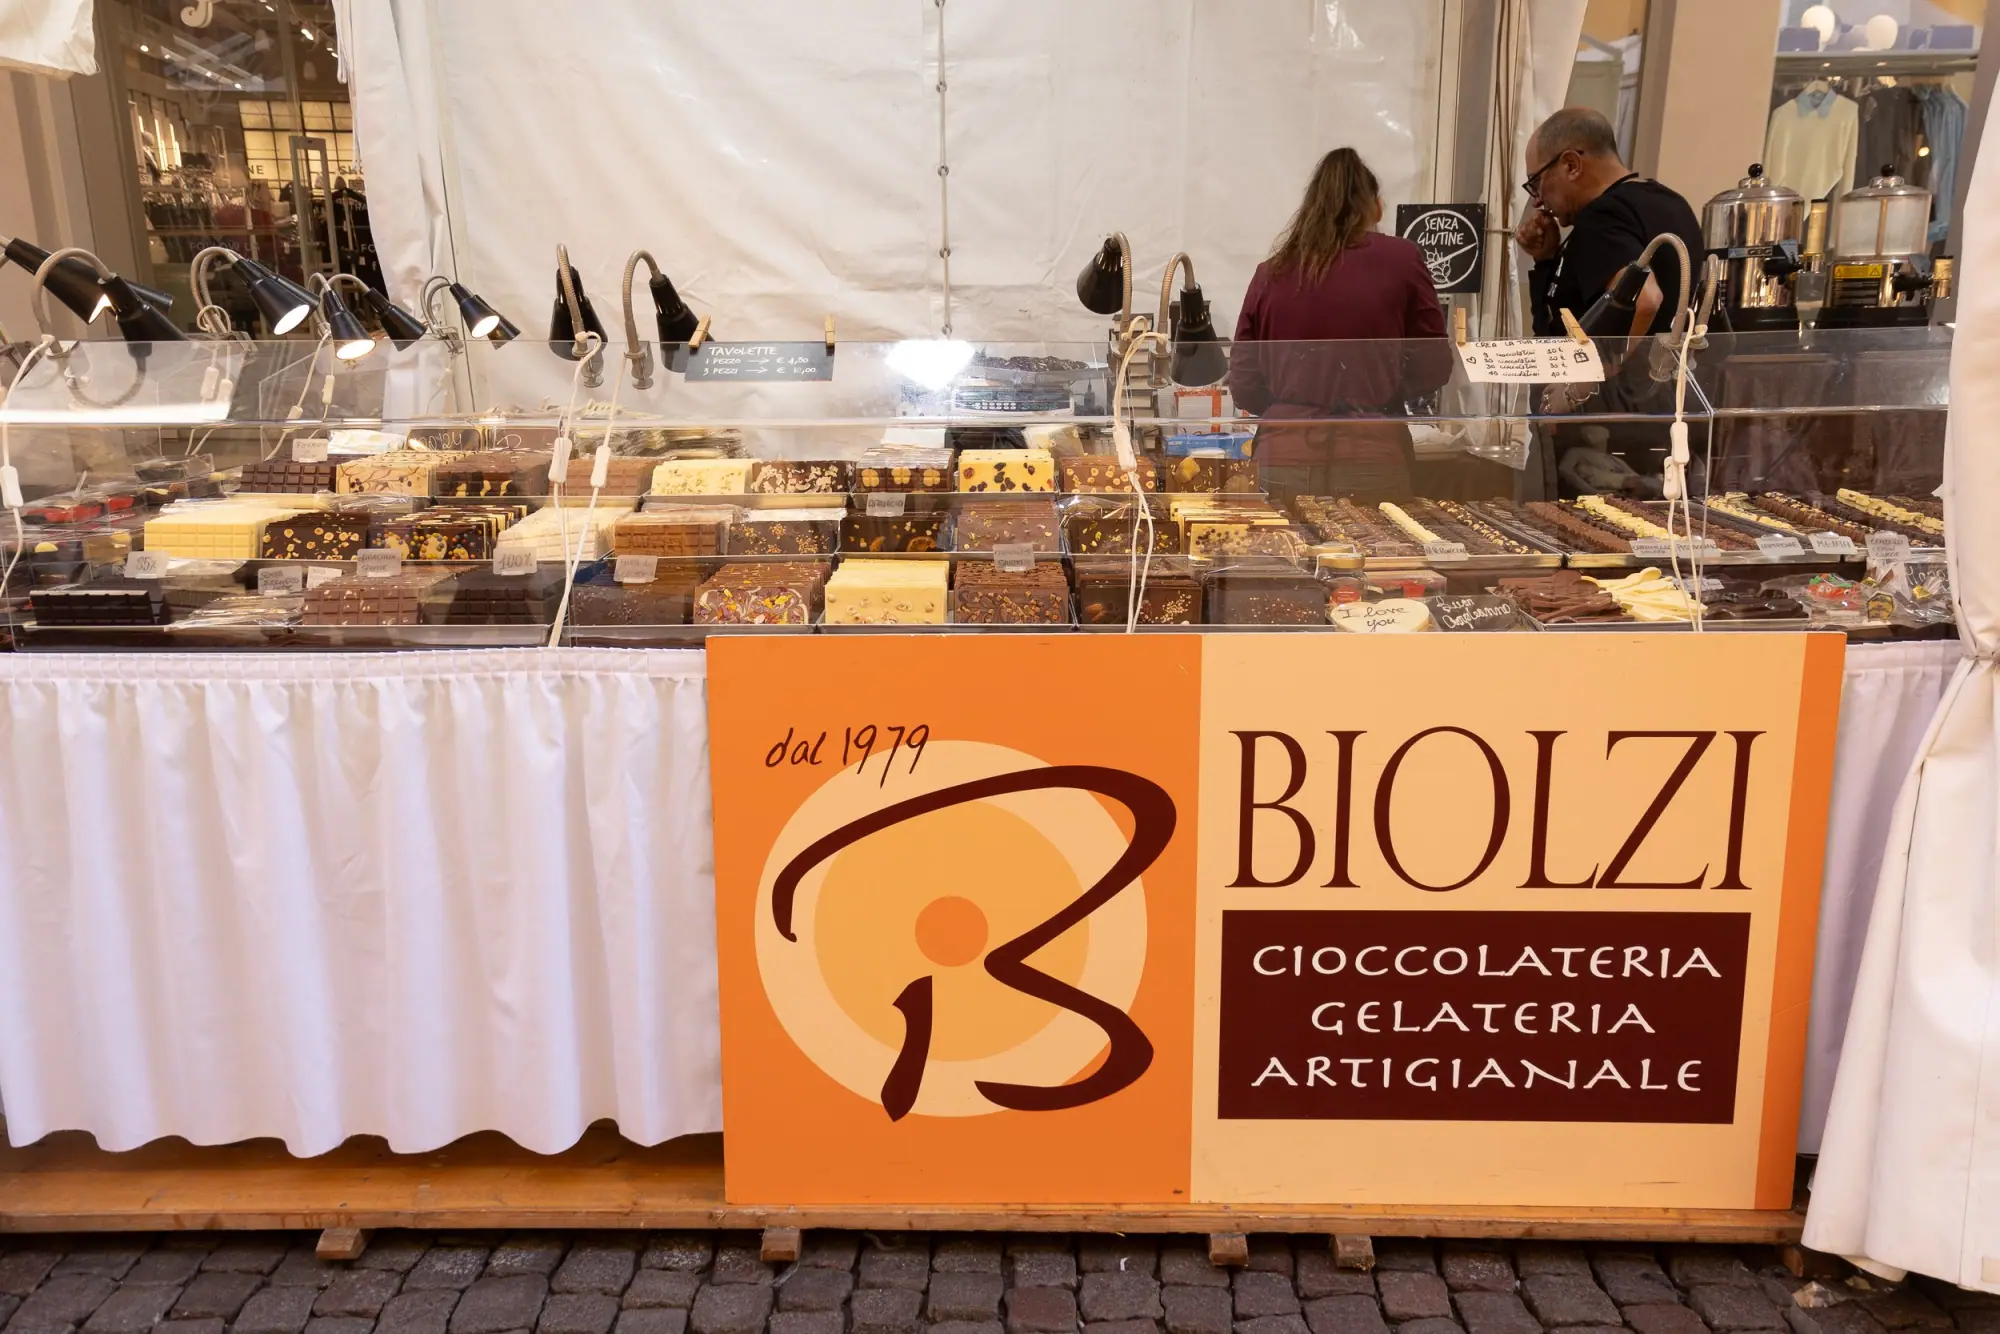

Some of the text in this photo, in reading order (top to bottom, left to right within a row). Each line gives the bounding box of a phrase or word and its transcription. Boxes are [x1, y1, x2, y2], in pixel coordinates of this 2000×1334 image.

[1425, 216, 1459, 231] SENZA
[1417, 231, 1464, 246] GLUTINE
[708, 346, 779, 356] TAVOLETTE
[788, 356, 809, 365] 4,50
[703, 368, 709, 376] 3
[712, 367, 739, 375] PEZZI
[1816, 538, 1851, 549] MENTA
[136, 556, 156, 572] 85%
[498, 552, 533, 569] 100%
[1338, 606, 1410, 619] I love
[1366, 617, 1396, 631] you
[765, 723, 930, 789] dal 1979
[1225, 726, 1767, 892] BIOLZI
[1253, 944, 1722, 979] CIOCCOLATERIA
[1311, 1000, 1656, 1035] GELATERIA
[1251, 1055, 1702, 1092] ARTIGIANALE
